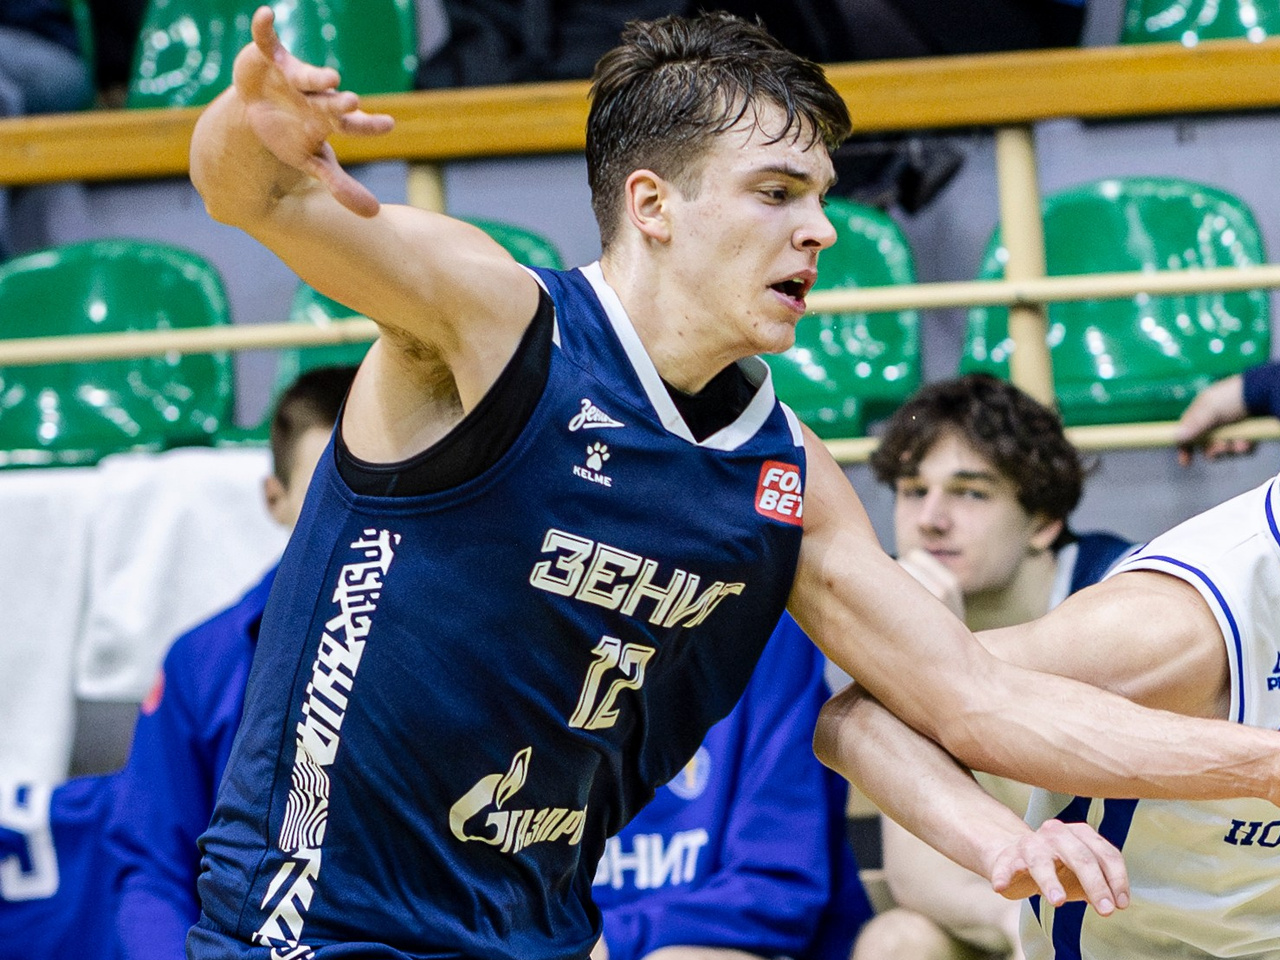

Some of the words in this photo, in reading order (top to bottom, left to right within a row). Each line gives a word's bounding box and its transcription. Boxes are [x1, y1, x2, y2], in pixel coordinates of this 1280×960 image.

[573, 465, 612, 487] KELME
[759, 488, 803, 518] BET
[530, 528, 746, 629] ЗЕНИТ
[568, 635, 656, 730] 12
